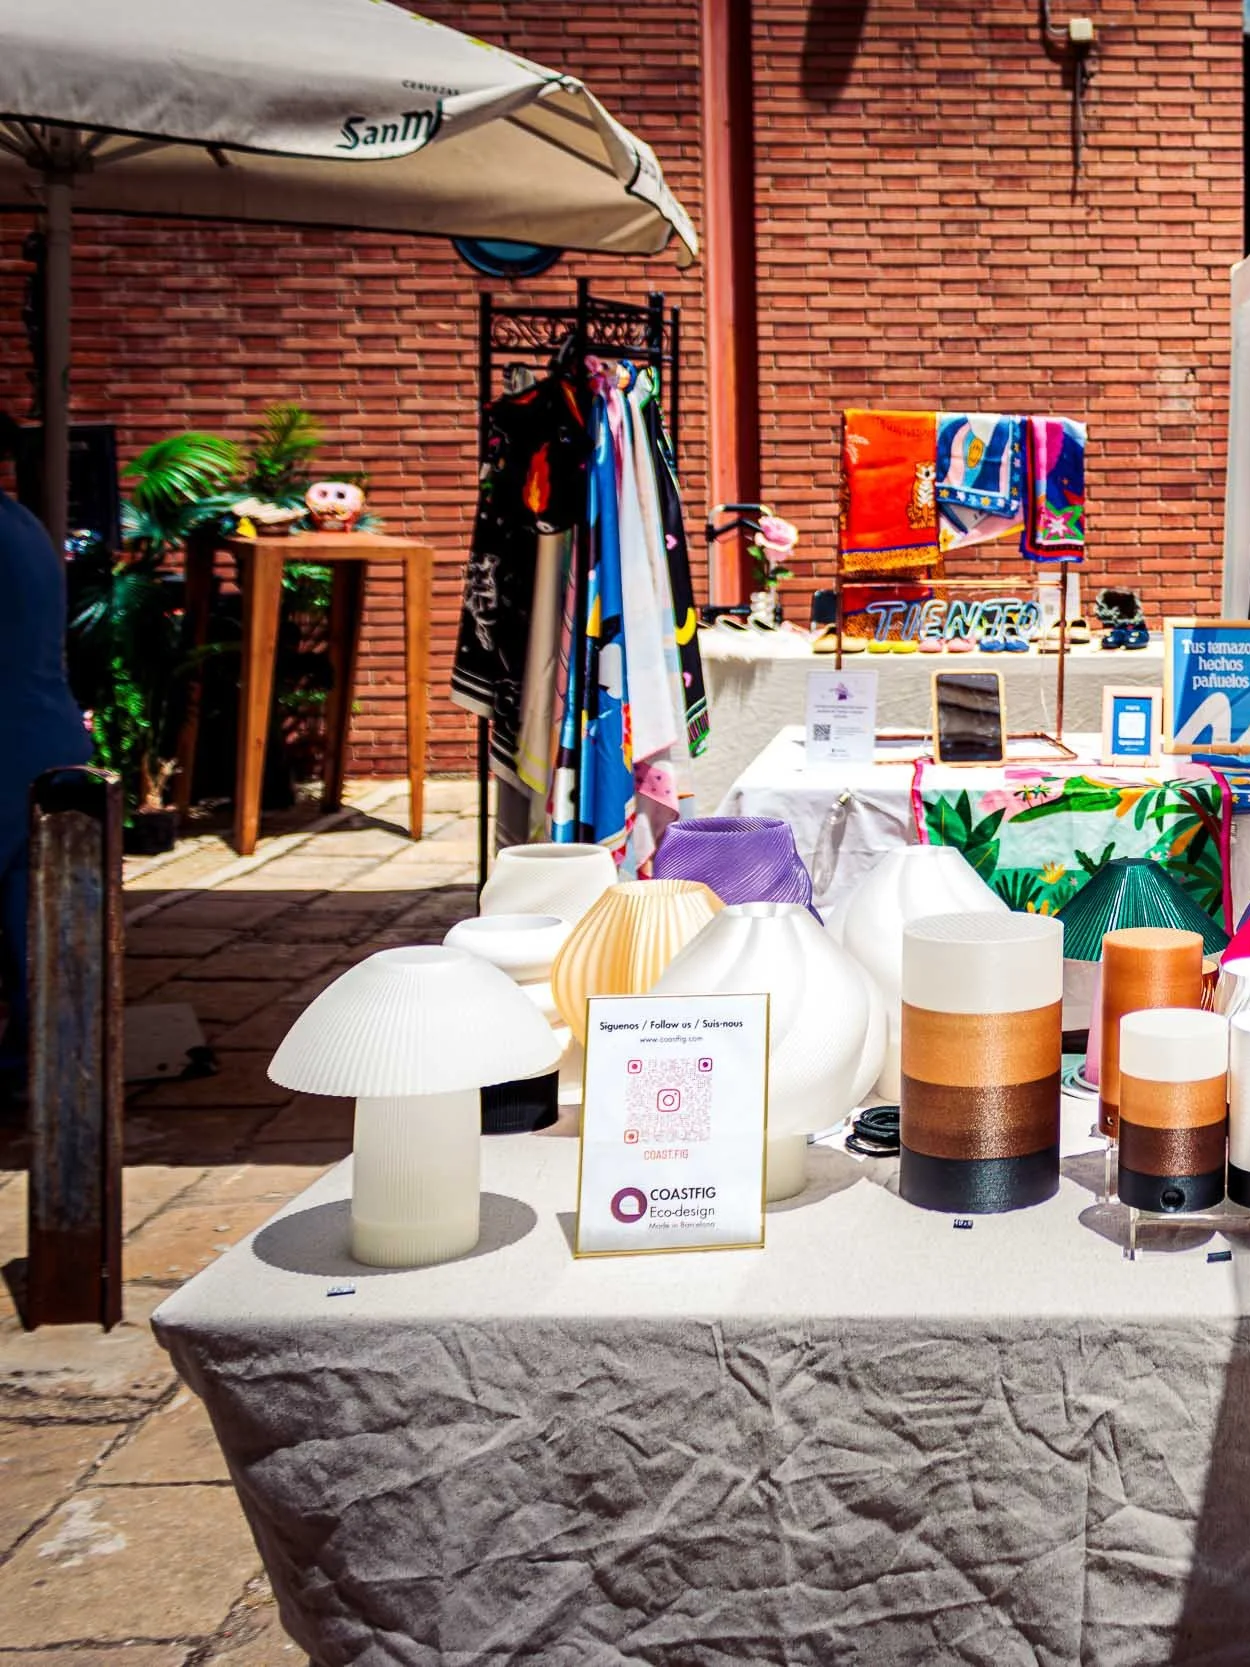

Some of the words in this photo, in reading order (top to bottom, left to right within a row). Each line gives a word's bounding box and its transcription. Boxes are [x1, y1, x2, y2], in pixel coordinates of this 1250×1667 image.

[402, 80, 459, 96] CERVEZAS
[867, 597, 1042, 642] TIENTO
[1181, 639, 1205, 655] Tus
[1198, 657, 1244, 671] hechos
[1192, 673, 1250, 690] pañuelos
[650, 1019, 680, 1029] Follow
[682, 1021, 692, 1029] us
[702, 1019, 744, 1029] Suis-nous
[650, 1187, 716, 1201] COASTFIG
[650, 1203, 715, 1220] Eco-design
